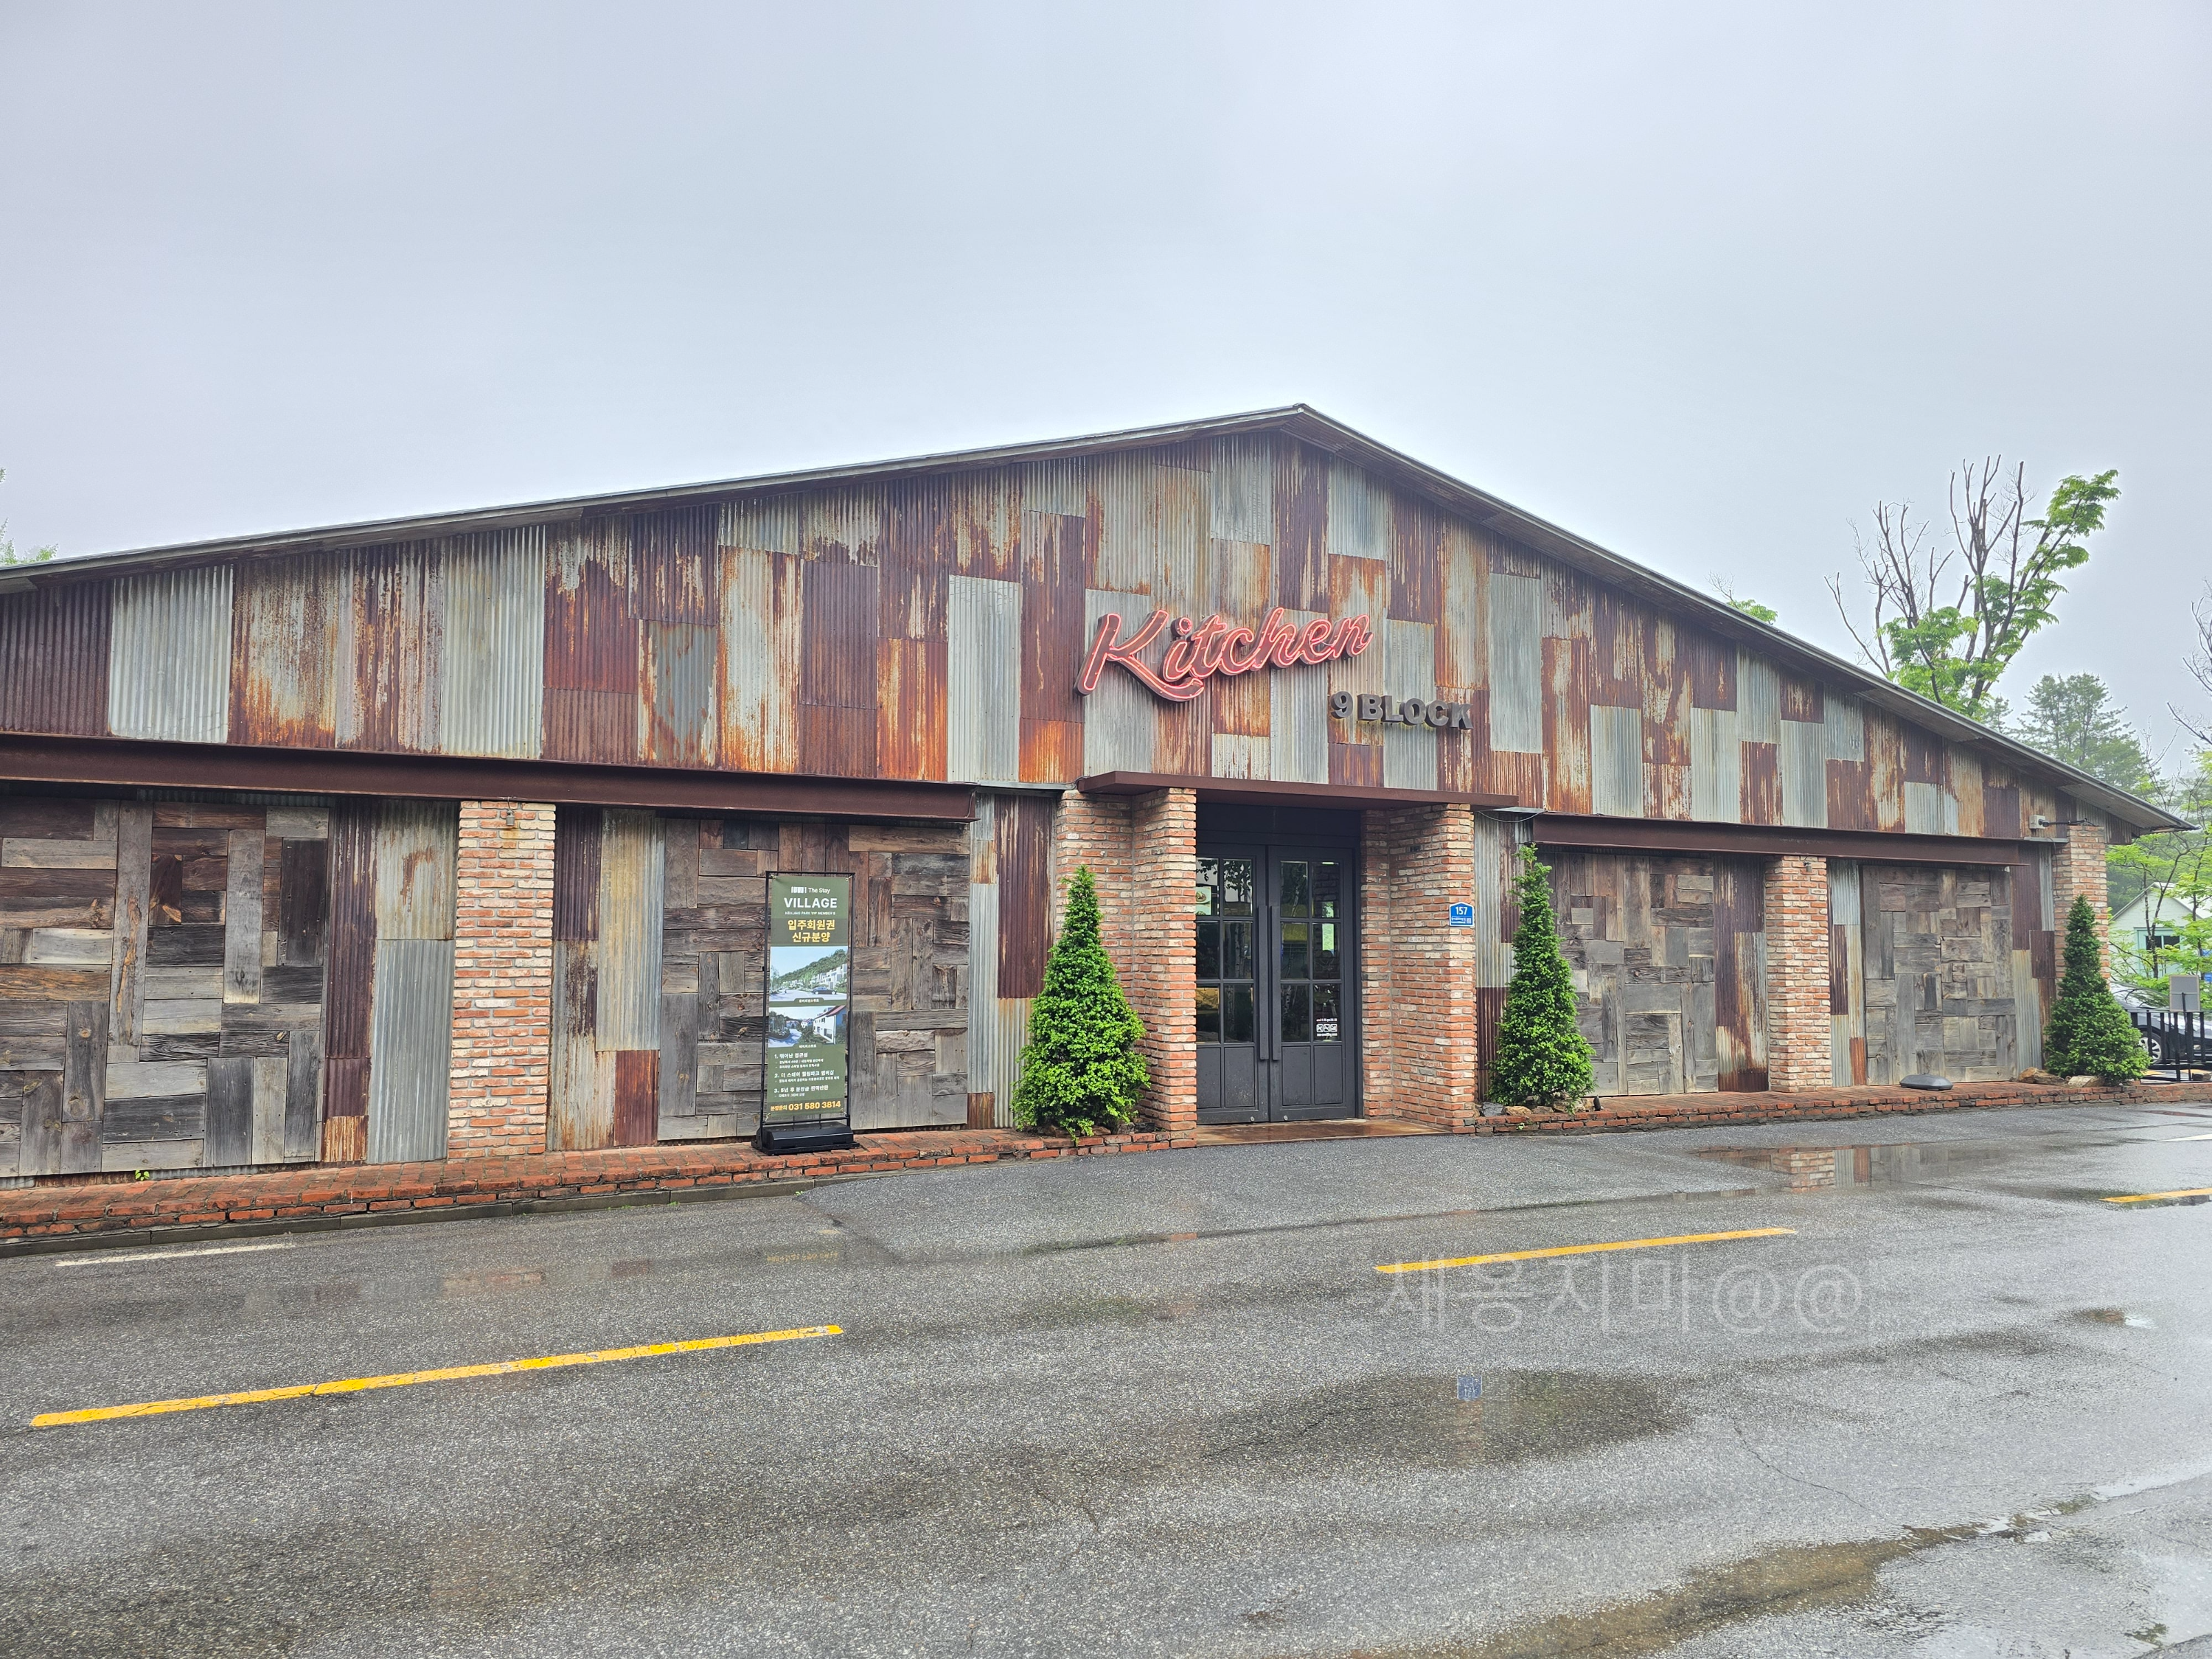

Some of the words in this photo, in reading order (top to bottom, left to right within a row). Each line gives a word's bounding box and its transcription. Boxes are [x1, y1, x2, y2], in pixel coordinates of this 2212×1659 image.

[1074, 607, 1373, 702] Kitchen
[1331, 691, 1354, 719] 9
[1357, 693, 1473, 730] BLOCK
[784, 897, 838, 908] VILLAGE
[1455, 906, 1468, 915] 157
[787, 919, 835, 930] 입주회원권
[792, 932, 831, 942] 신규분양
[804, 1102, 820, 1110] 580
[821, 1100, 841, 1108] 3814
